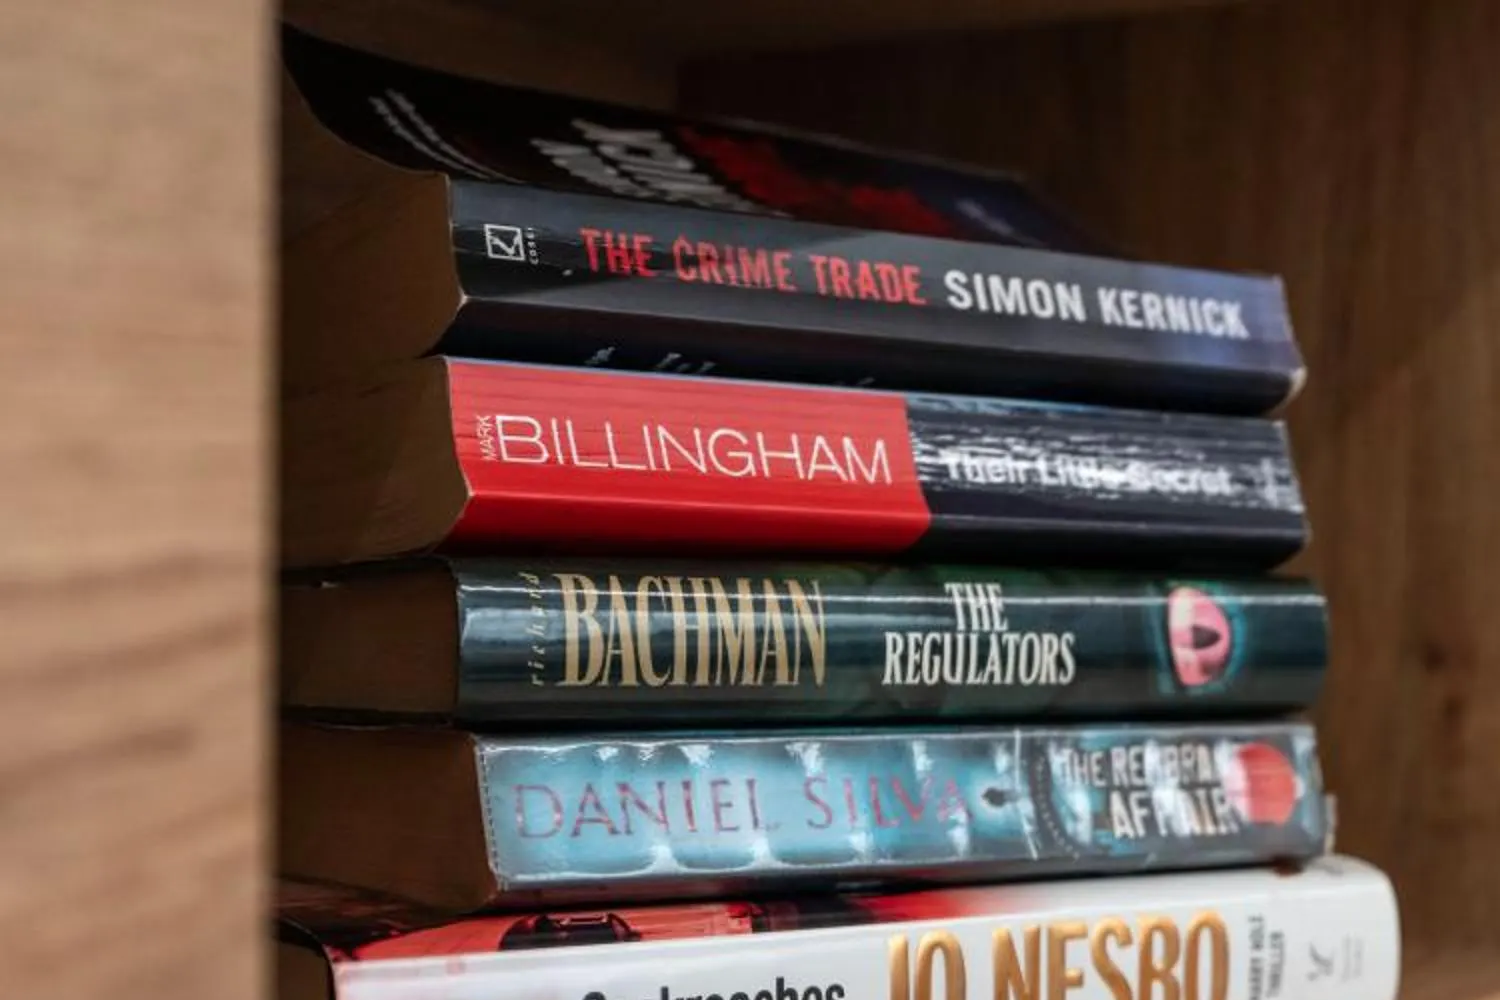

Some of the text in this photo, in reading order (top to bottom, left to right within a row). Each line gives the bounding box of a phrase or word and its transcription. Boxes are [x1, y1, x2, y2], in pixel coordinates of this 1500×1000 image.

[580, 227, 928, 305] THE CRIME TRADE
[943, 270, 1250, 340] SIMON KERNICK
[476, 414, 498, 461] MARK
[495, 413, 893, 485] BILLINGHAM
[940, 449, 1029, 485] Their
[552, 572, 828, 688] BACHMAN
[944, 581, 1008, 632] THE
[882, 631, 1076, 686] REGULATORS
[512, 774, 974, 839] DANIEL SILVA
